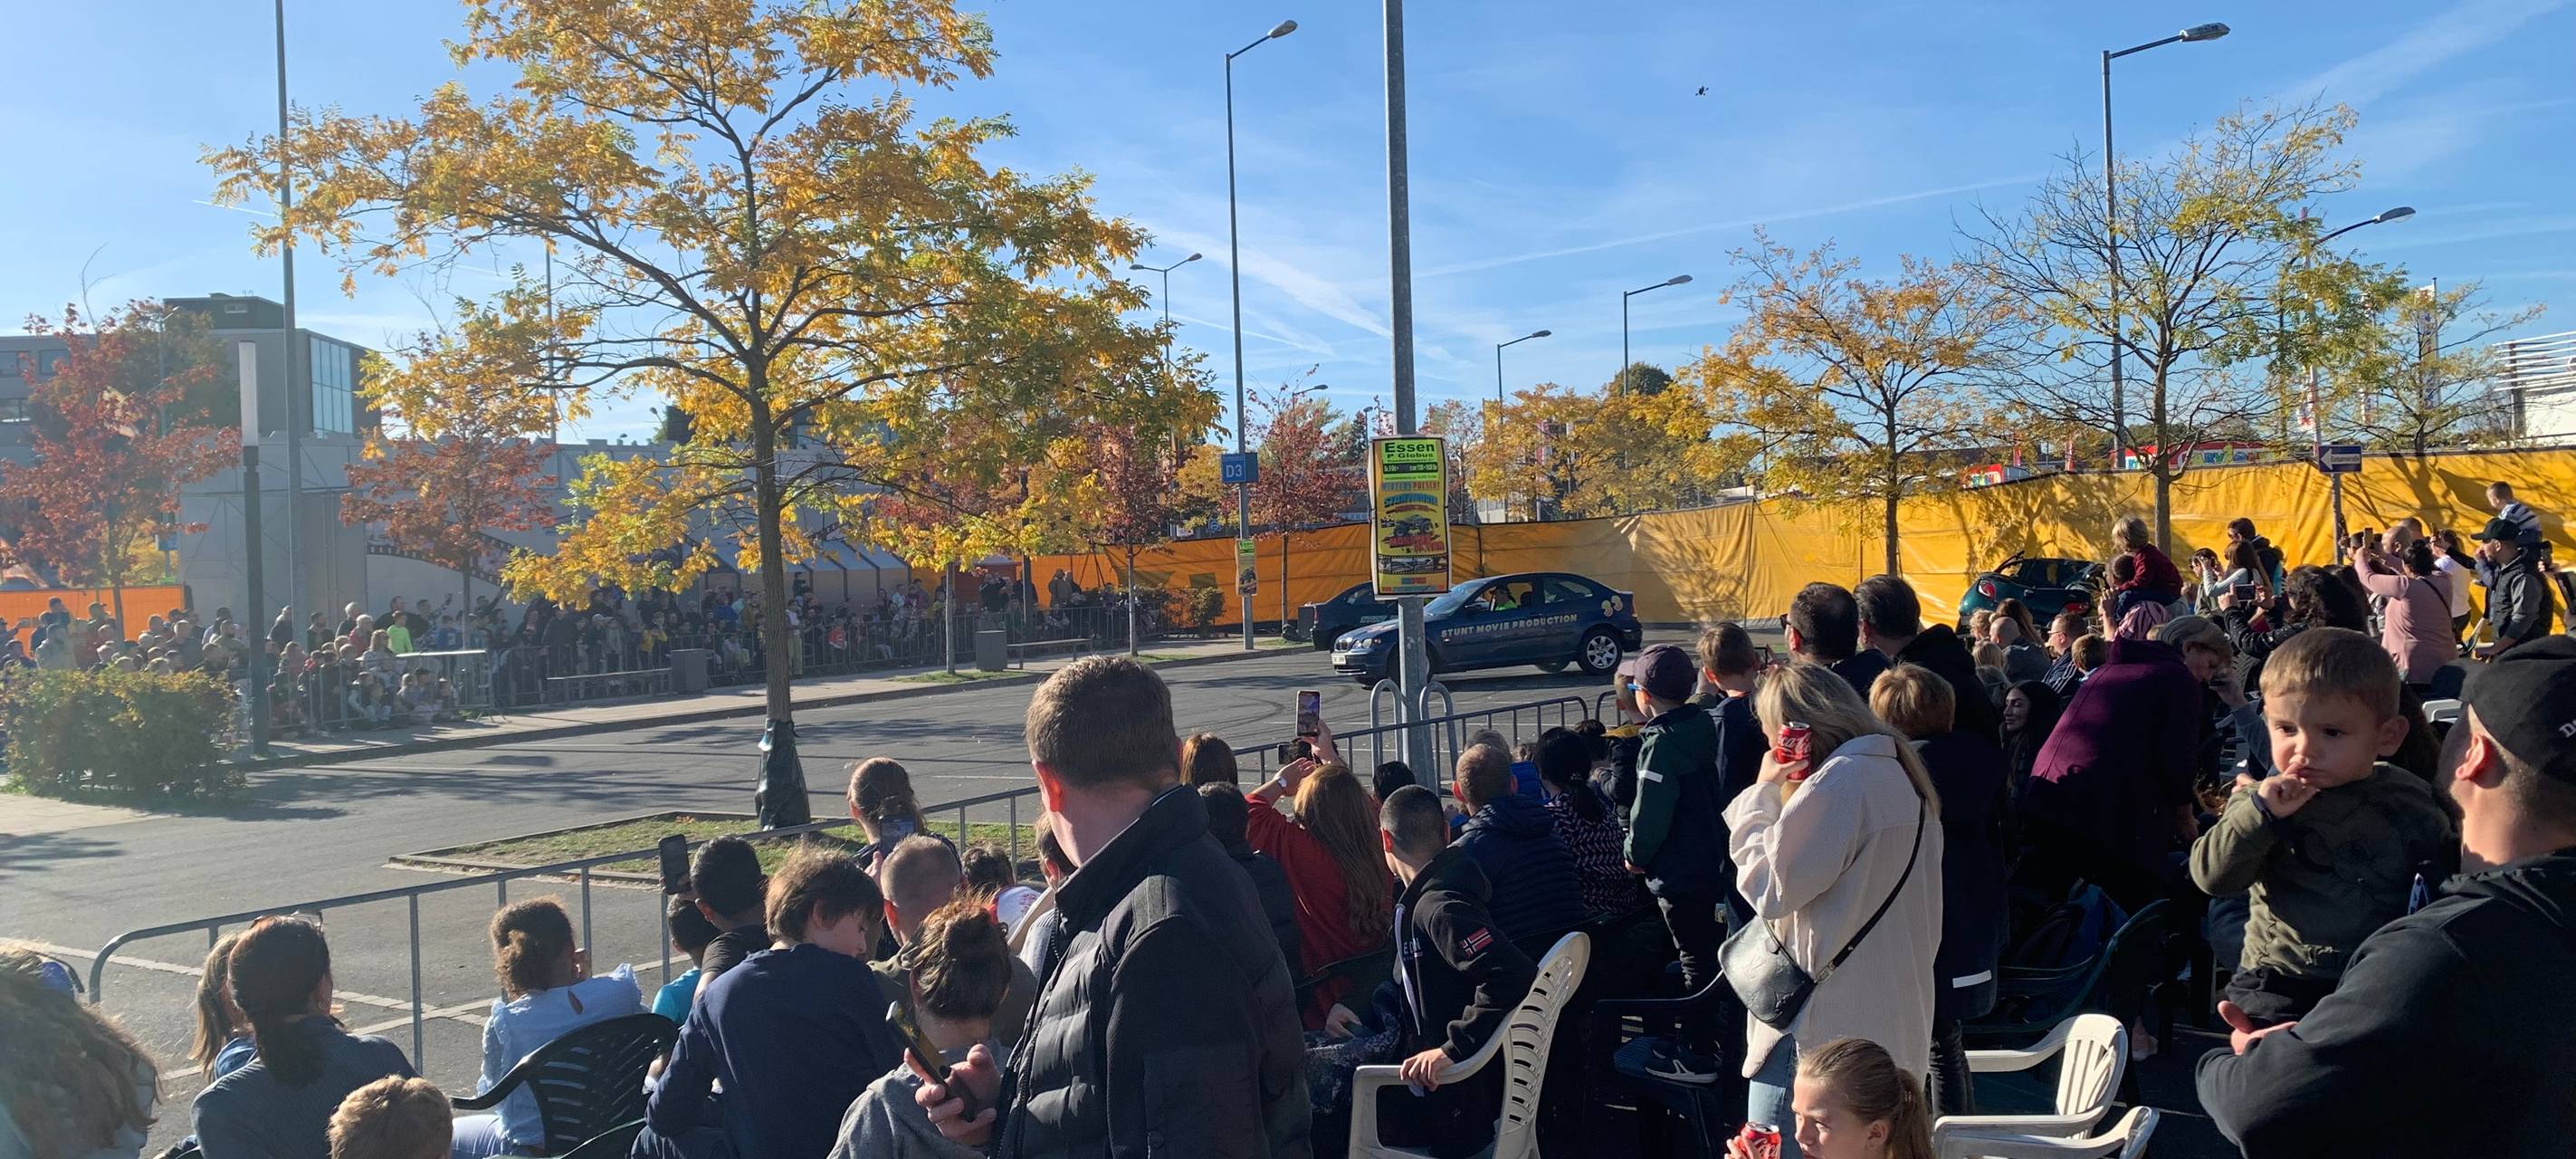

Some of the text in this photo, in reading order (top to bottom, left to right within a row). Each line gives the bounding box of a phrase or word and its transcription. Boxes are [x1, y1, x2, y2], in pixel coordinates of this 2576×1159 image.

[1384, 442, 1435, 453] Essen
[1226, 465, 1243, 478] D3
[1441, 613, 1578, 638] STUNT MOVIE PRODUCTION
